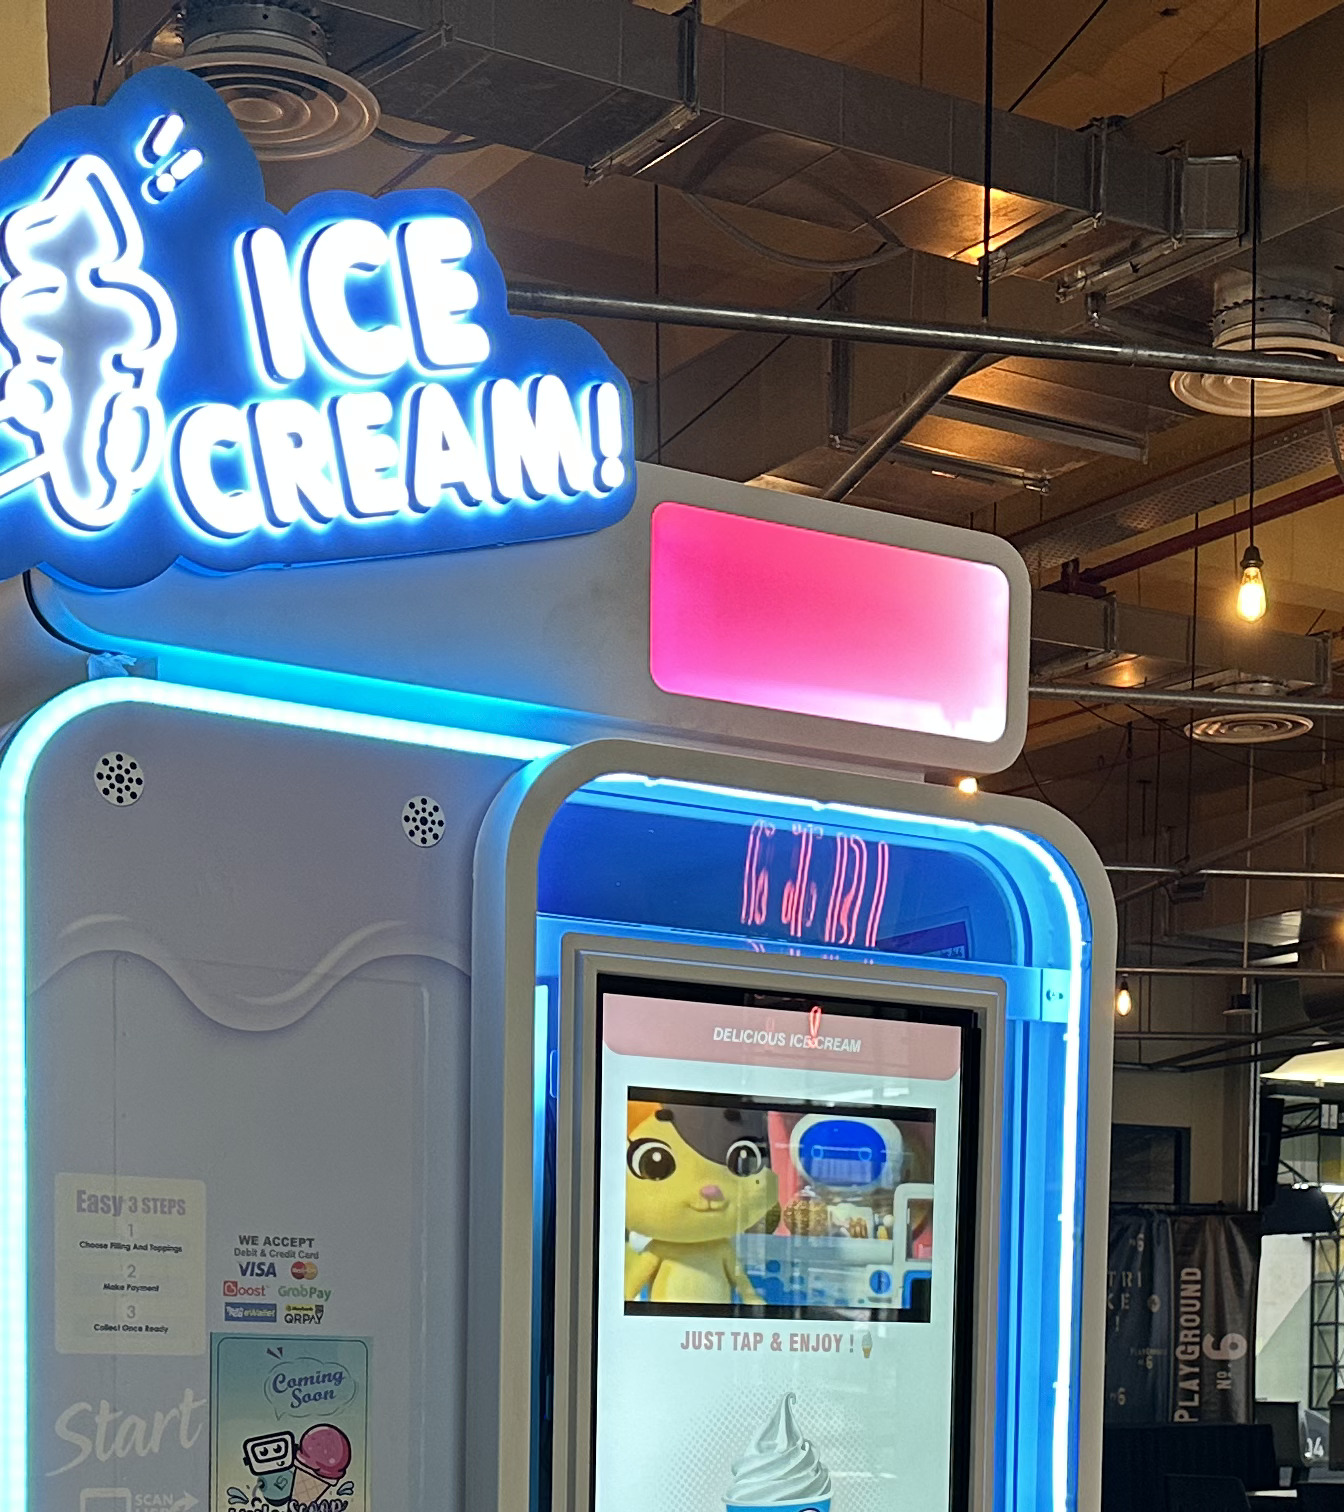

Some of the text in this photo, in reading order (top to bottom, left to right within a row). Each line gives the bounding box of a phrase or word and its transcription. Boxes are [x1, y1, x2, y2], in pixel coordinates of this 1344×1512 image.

[242, 217, 490, 385] ICE
[173, 374, 625, 540] CREAM!
[713, 1027, 862, 1053] DELICIOUS ICE CREAM
[76, 1189, 186, 1217] Easy 3 STEPS
[128, 1224, 134, 1237] 1
[79, 1241, 108, 1249] Choose
[150, 1244, 183, 1253] Toppings
[239, 1235, 315, 1248] WE ACCEPT
[234, 1248, 319, 1259] Debit & Credit Card
[127, 1264, 136, 1278] 2
[239, 1261, 276, 1277] VISA
[127, 1284, 159, 1292] Payment
[278, 1285, 332, 1302] GrabPay
[127, 1305, 136, 1318] 3
[94, 1324, 168, 1334] Collect Once Ready
[680, 1330, 725, 1351] JUST
[731, 1331, 763, 1351] TAP
[770, 1332, 782, 1352] &
[790, 1333, 843, 1353] ENJOY
[1174, 1267, 1202, 1423] PLAYGROUND
[1202, 1332, 1248, 1361] 6
[272, 1370, 345, 1394] Coming
[290, 1387, 336, 1409] Soon
[45, 1388, 206, 1477] Start
[135, 1494, 174, 1506] SCAN
